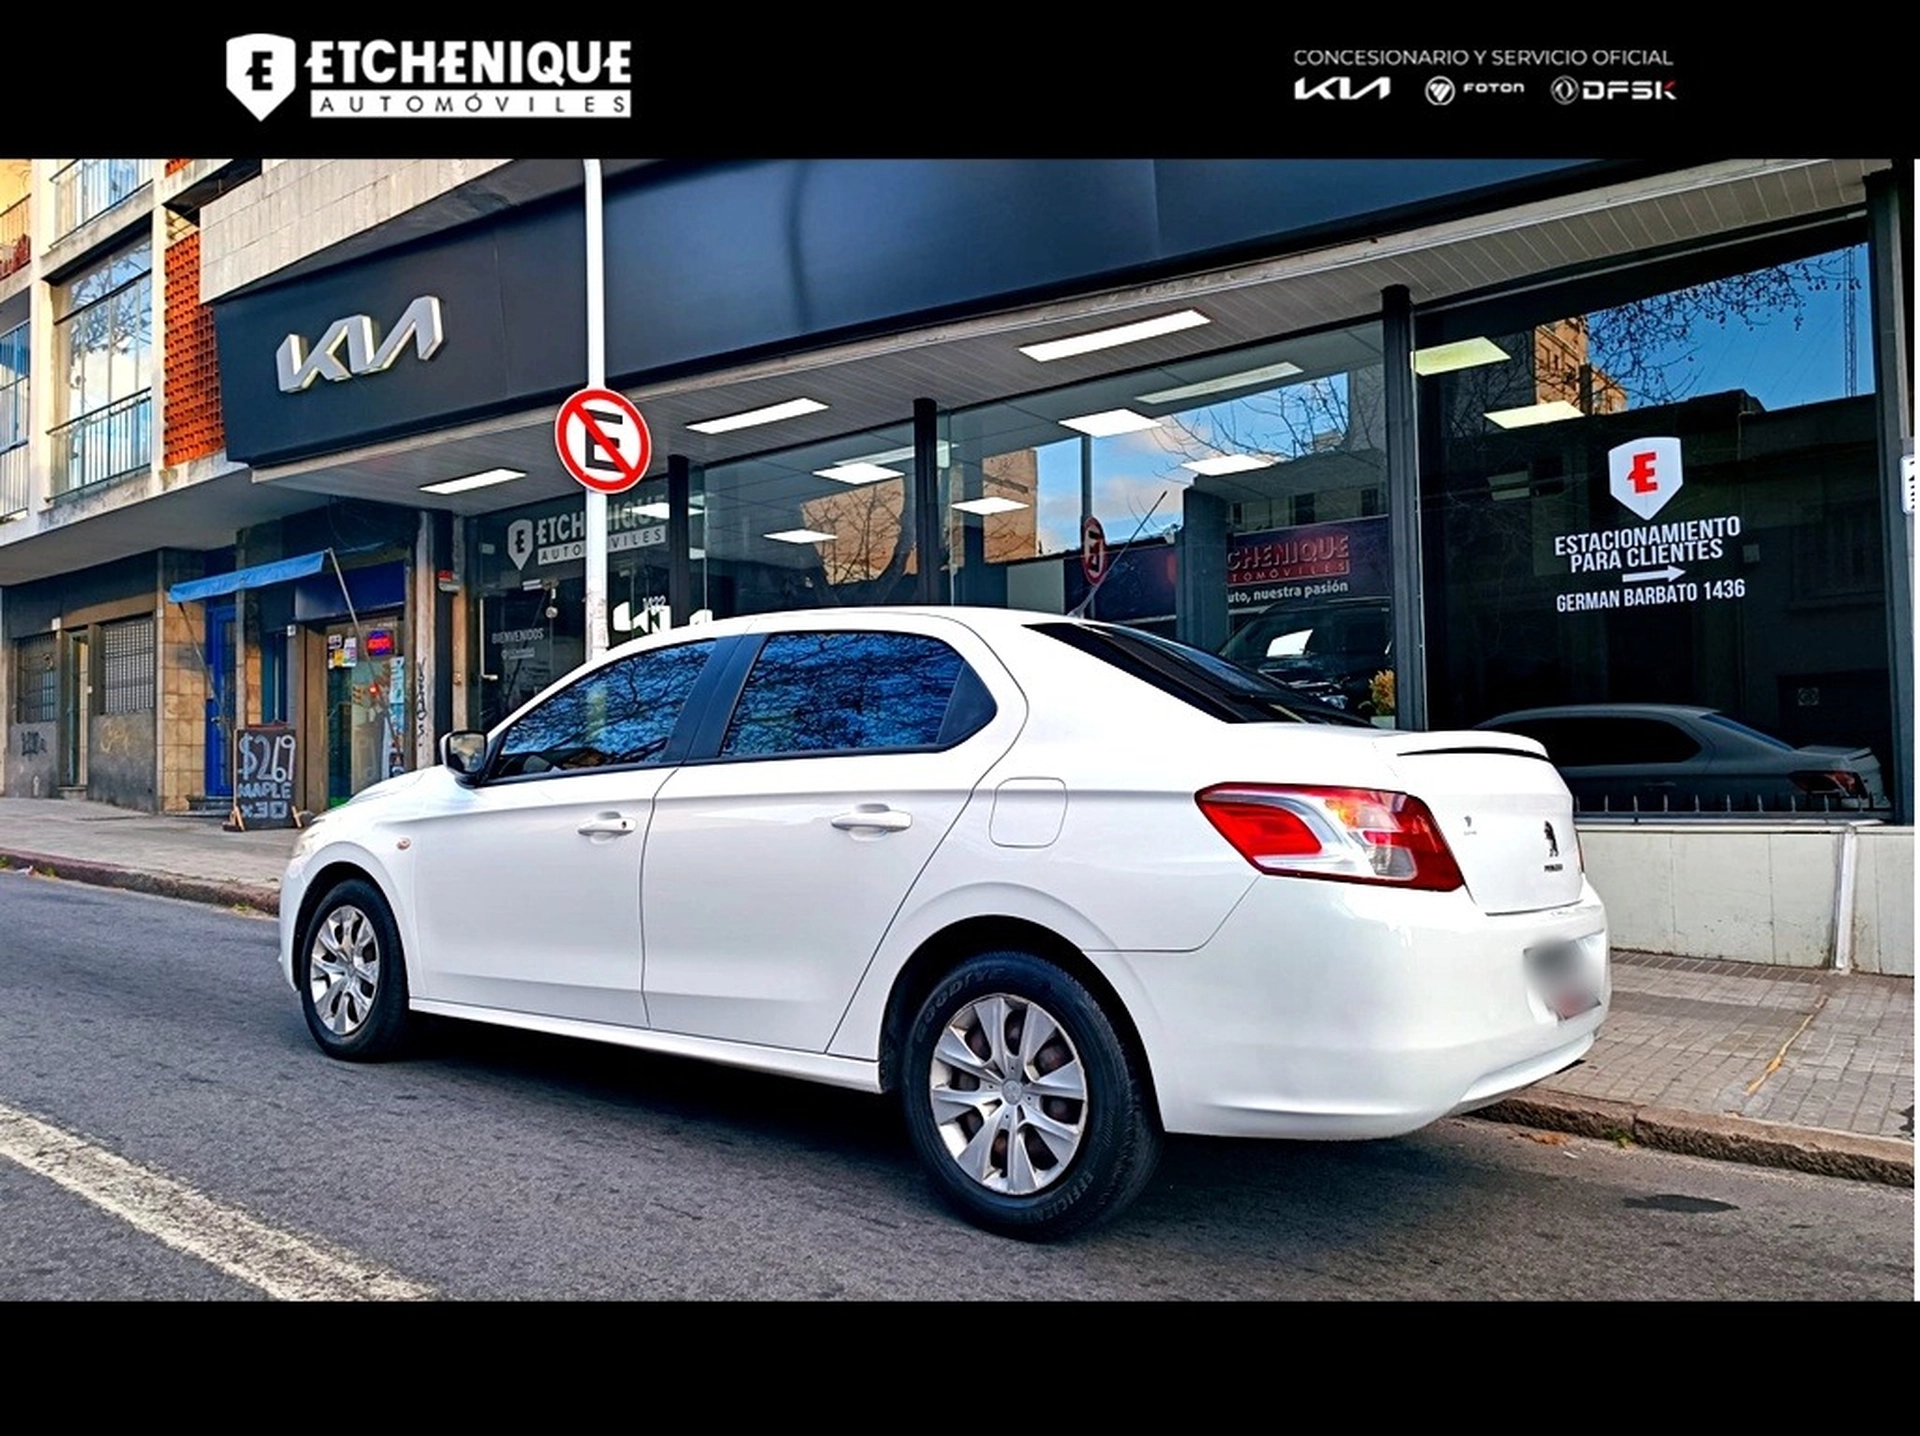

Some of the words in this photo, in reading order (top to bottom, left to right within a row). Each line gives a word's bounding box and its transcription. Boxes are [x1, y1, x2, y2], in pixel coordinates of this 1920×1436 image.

[276, 295, 443, 393] KIA
[585, 408, 623, 474] E
[540, 528, 662, 562] AUTOVILES
[1555, 515, 1741, 556] ESTACIONAMIENTO
[1571, 550, 1622, 573] PARA
[1626, 538, 1723, 567] CLIENTES
[1254, 583, 1301, 601] nuestra
[1304, 580, 1348, 598] pasión
[1556, 590, 1620, 612] GERMAN
[1624, 582, 1698, 607] BARBATO
[1703, 578, 1745, 600] 1436
[238, 732, 296, 782] $269
[238, 782, 292, 799] MAPLE
